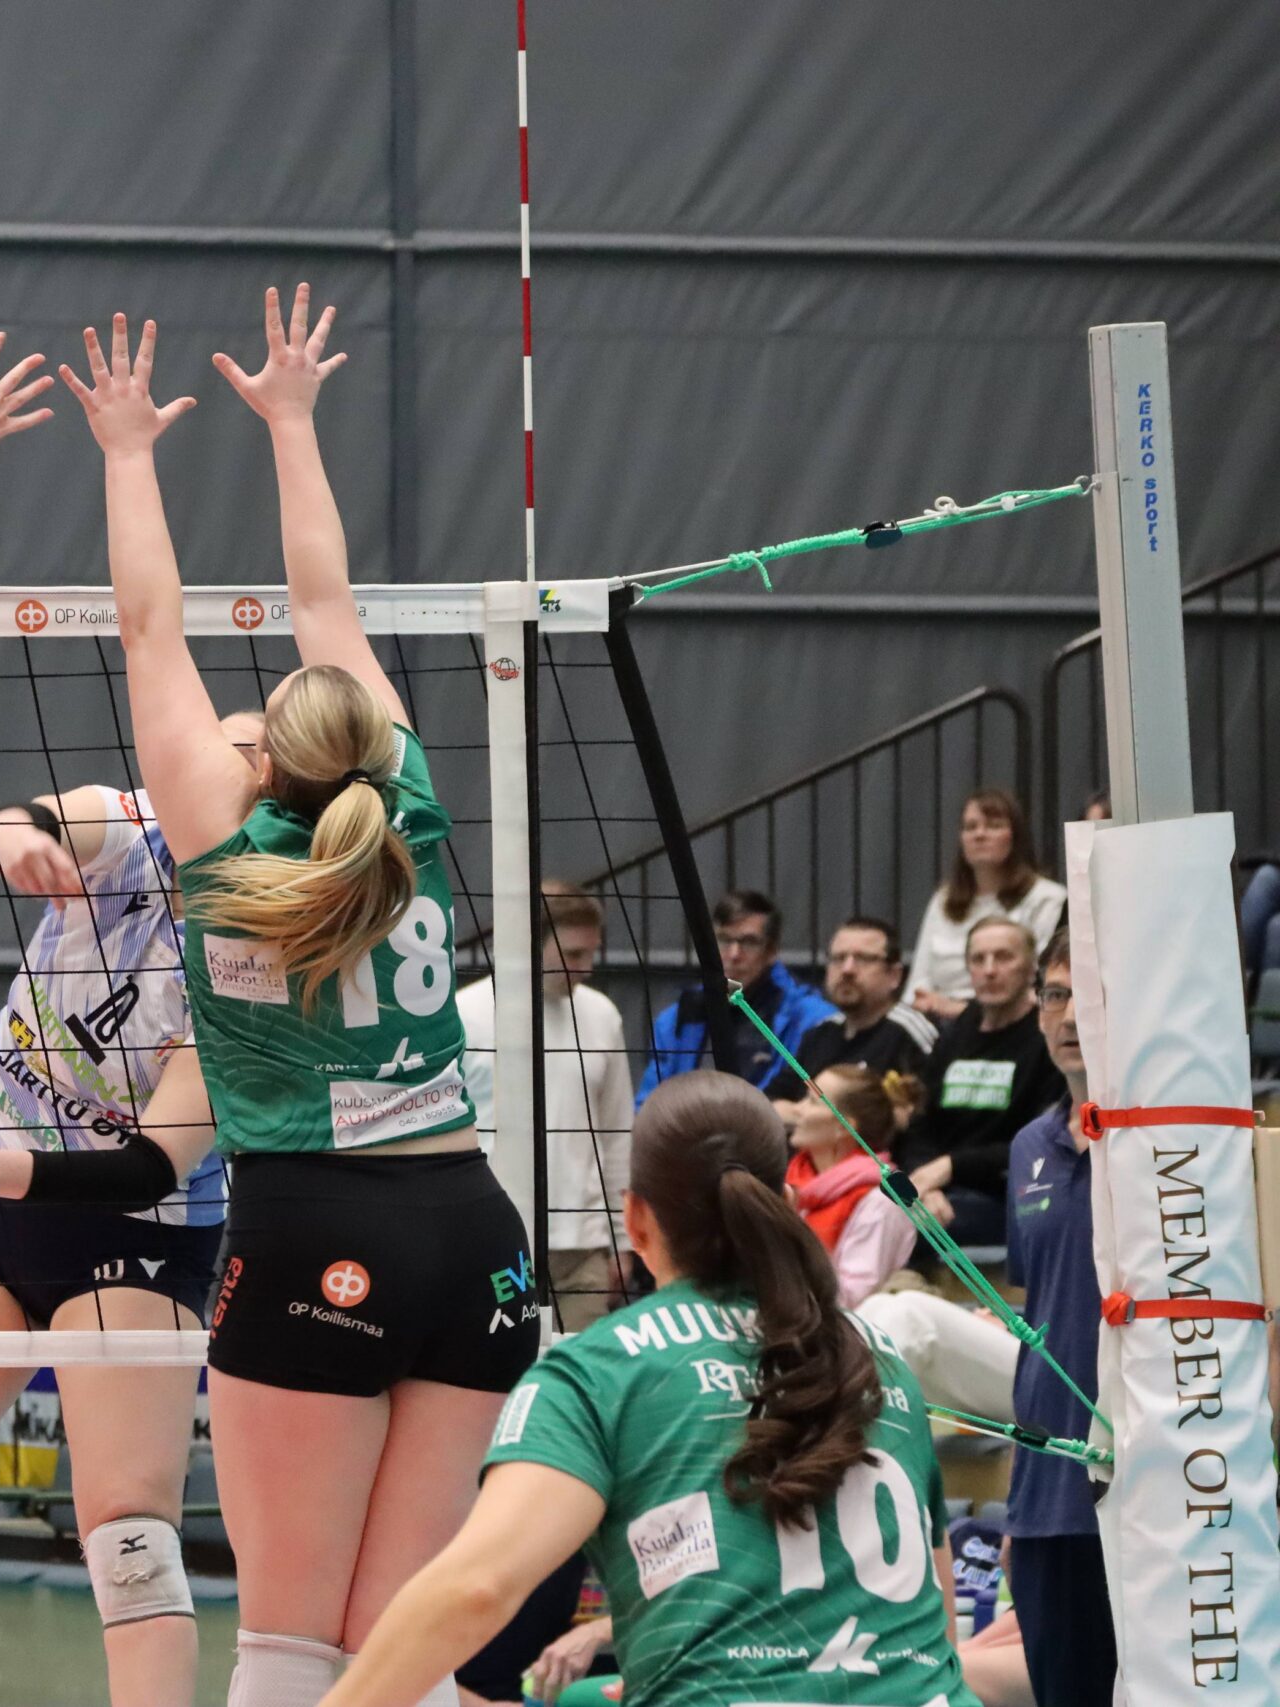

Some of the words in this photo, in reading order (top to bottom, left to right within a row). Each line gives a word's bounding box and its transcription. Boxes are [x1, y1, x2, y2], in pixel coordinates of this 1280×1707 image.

[1138, 383, 1155, 467] KERKO
[1144, 478, 1158, 552] sport
[55, 608, 76, 624] OP
[80, 608, 119, 624] Koillis
[339, 896, 452, 1029] 18
[288, 1302, 310, 1316] OP
[311, 1305, 385, 1339] Koillismaa
[1152, 1143, 1223, 1430] MEMBER
[775, 1447, 927, 1603] 10
[1183, 1448, 1233, 1530] OF
[634, 1520, 708, 1557] Kujalan
[727, 1645, 810, 1660] KANTOLA
[1188, 1551, 1240, 1689] THE
